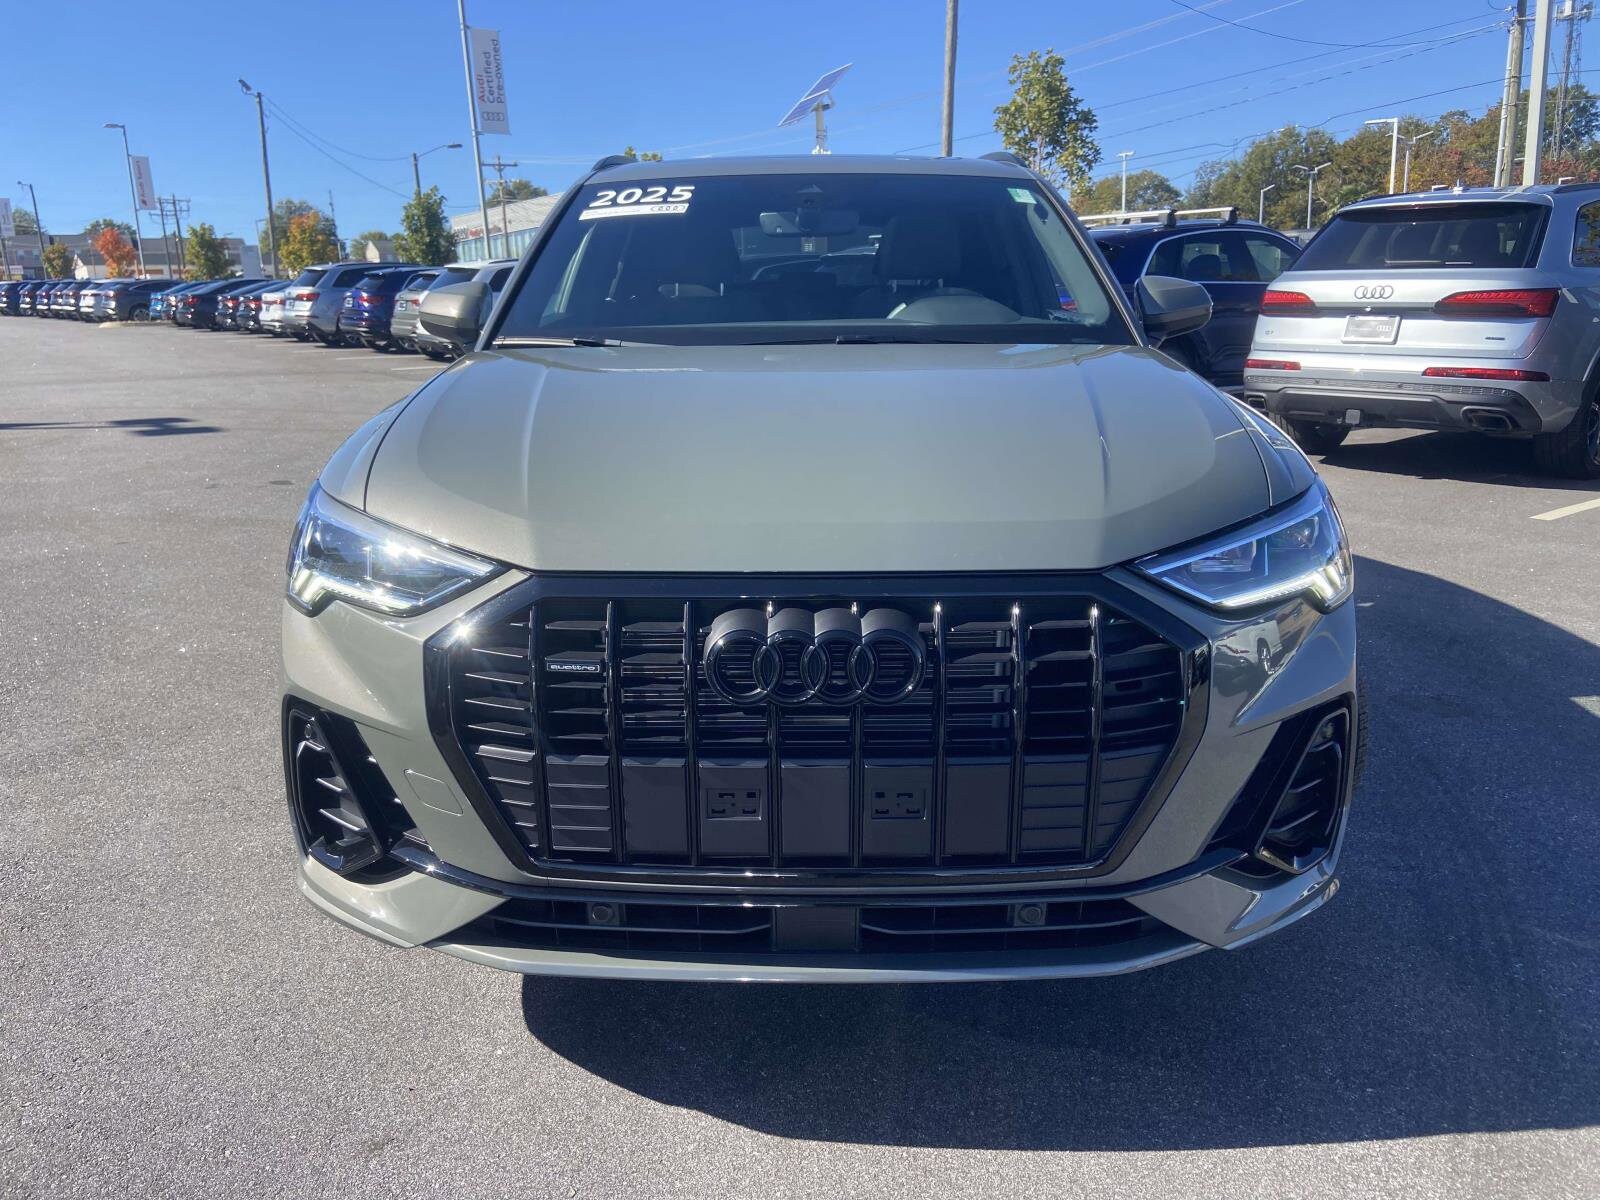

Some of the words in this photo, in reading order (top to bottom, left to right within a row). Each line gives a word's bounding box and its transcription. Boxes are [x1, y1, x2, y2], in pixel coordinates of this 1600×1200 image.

[477, 74, 487, 104] Audi
[483, 51, 495, 104] Certified
[491, 39, 505, 104] Pre-owned
[588, 186, 696, 208] 2025
